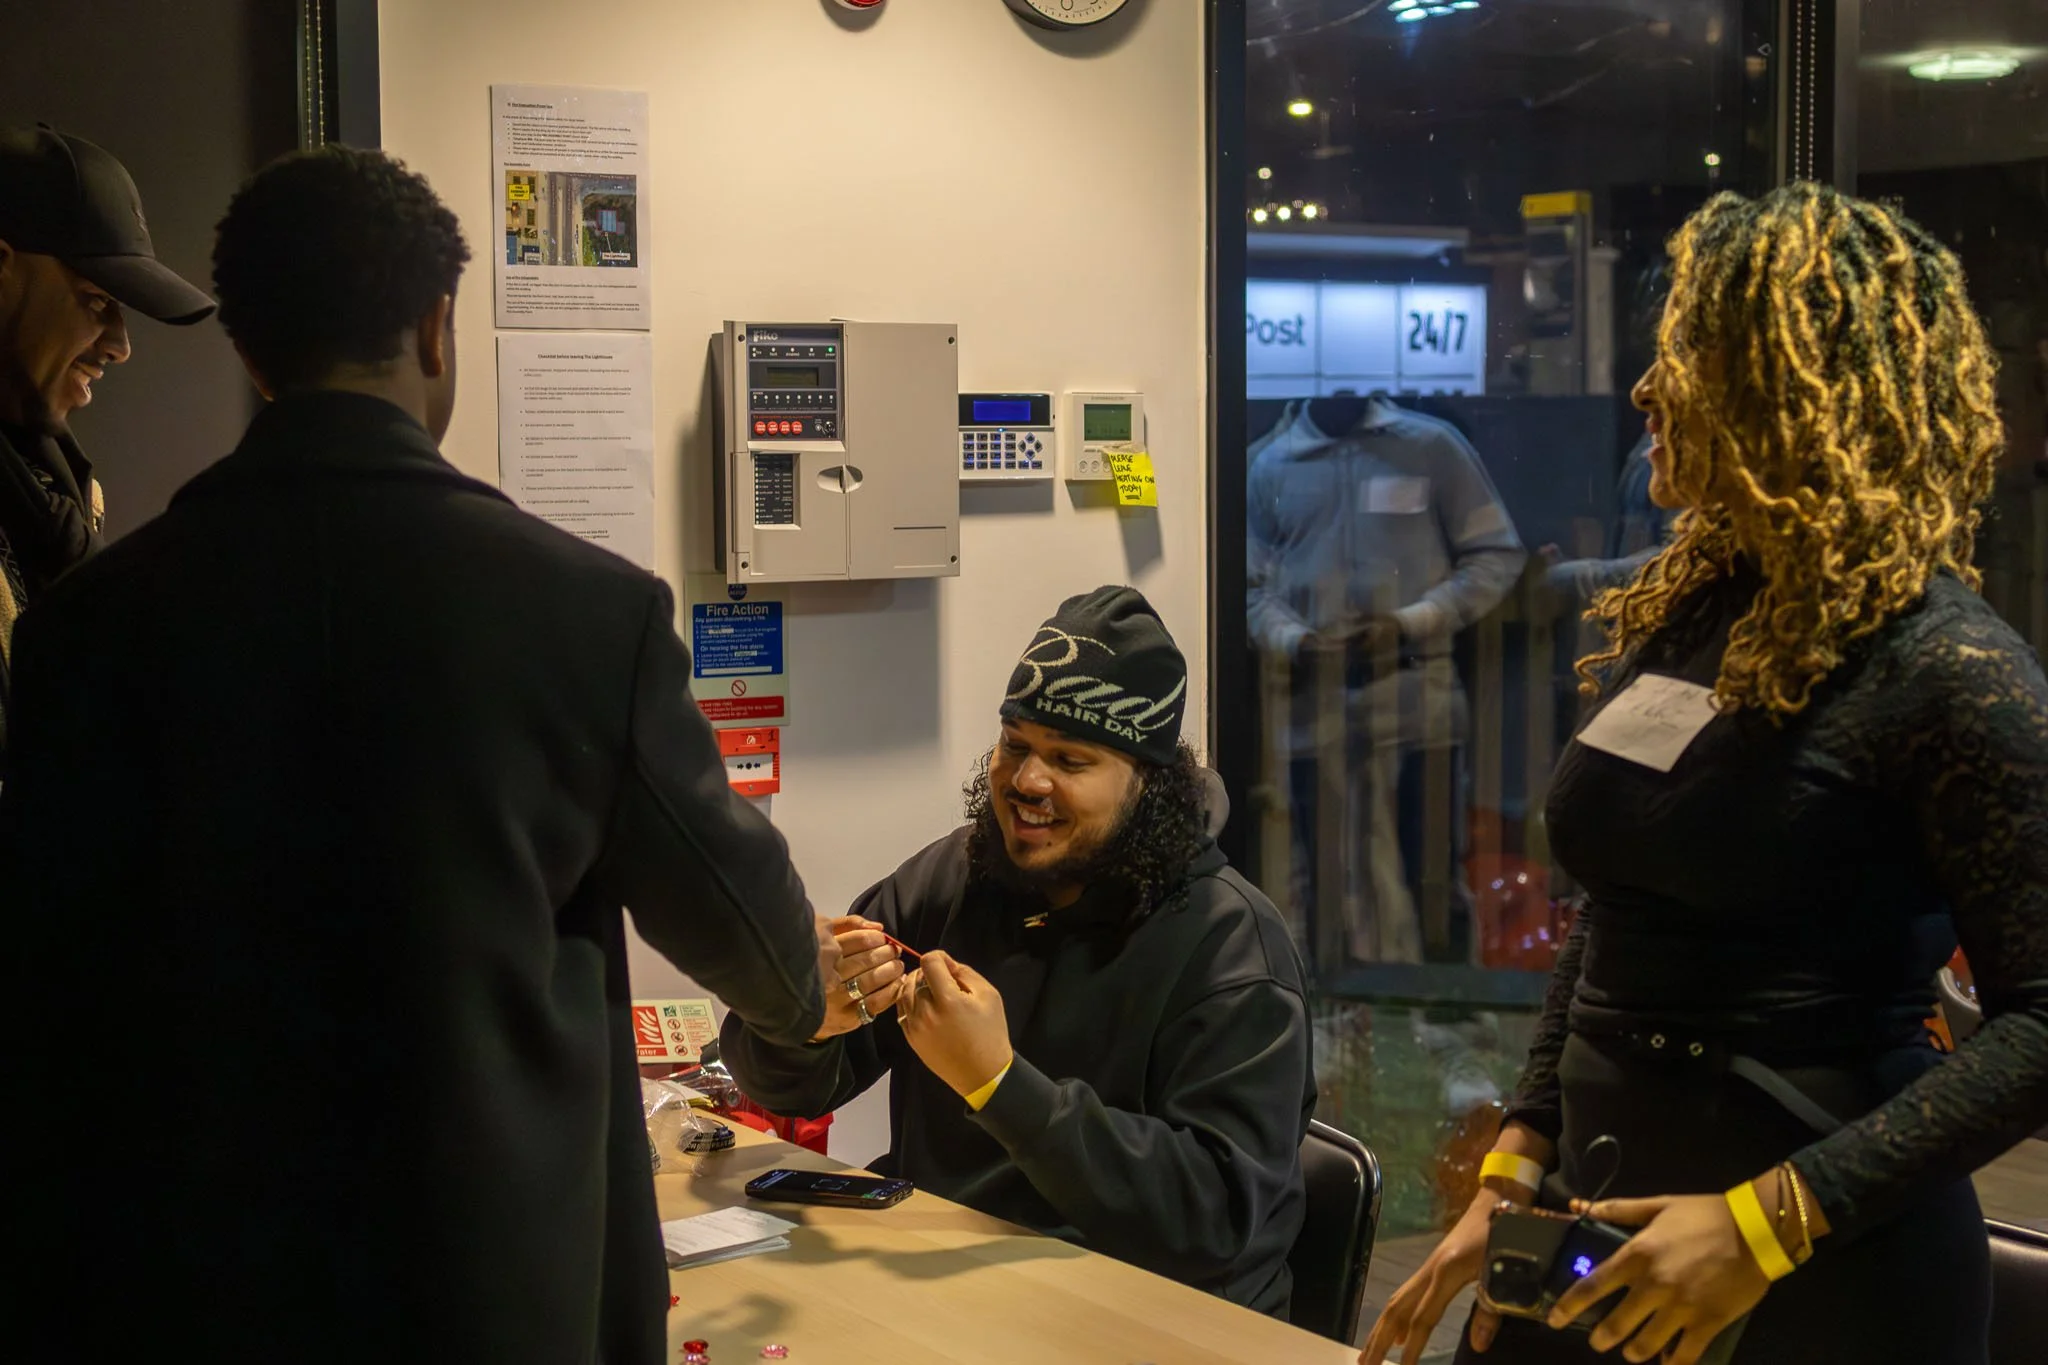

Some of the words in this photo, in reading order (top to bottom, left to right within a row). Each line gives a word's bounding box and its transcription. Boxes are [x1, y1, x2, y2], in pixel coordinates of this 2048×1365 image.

[1408, 307, 1469, 355] 24/7
[1110, 454, 1134, 463] PLEASE
[1115, 474, 1143, 483] HEATING
[1144, 475, 1155, 485] ON
[1119, 484, 1142, 497] TODAY
[706, 605, 729, 617] Fire
[732, 604, 769, 616] Action
[1036, 698, 1102, 726] HAIR
[1105, 718, 1148, 743] DAY
